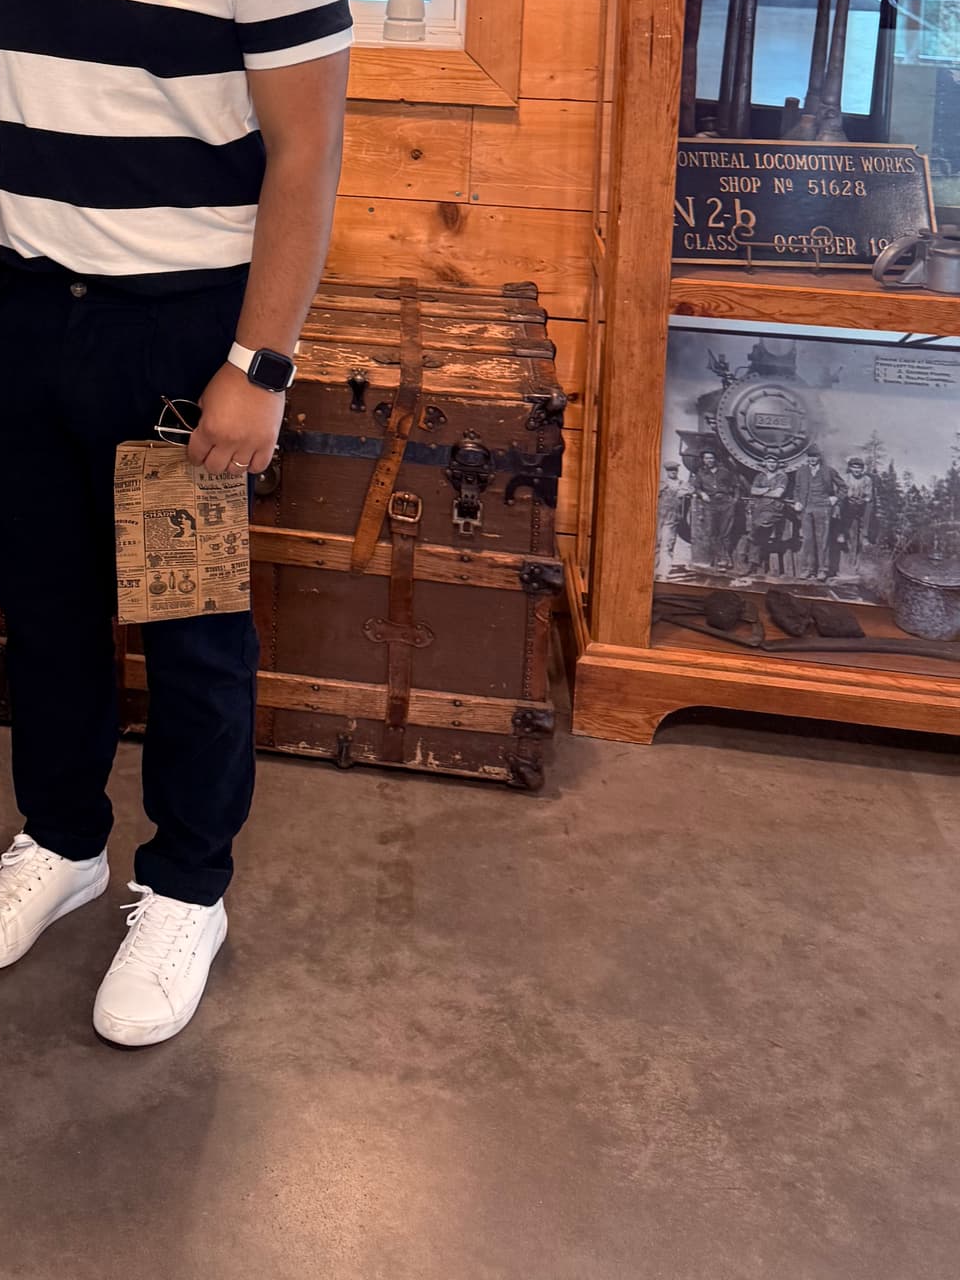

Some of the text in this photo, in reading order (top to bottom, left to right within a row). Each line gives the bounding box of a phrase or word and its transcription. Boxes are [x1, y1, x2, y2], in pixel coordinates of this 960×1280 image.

[677, 150, 916, 174] ONTREAL LOCOMOTIVE WORKS
[719, 176, 761, 193] SHOP
[807, 179, 867, 197] 51628
[683, 232, 738, 252] CLASS
[773, 234, 859, 257] OCTOBER
